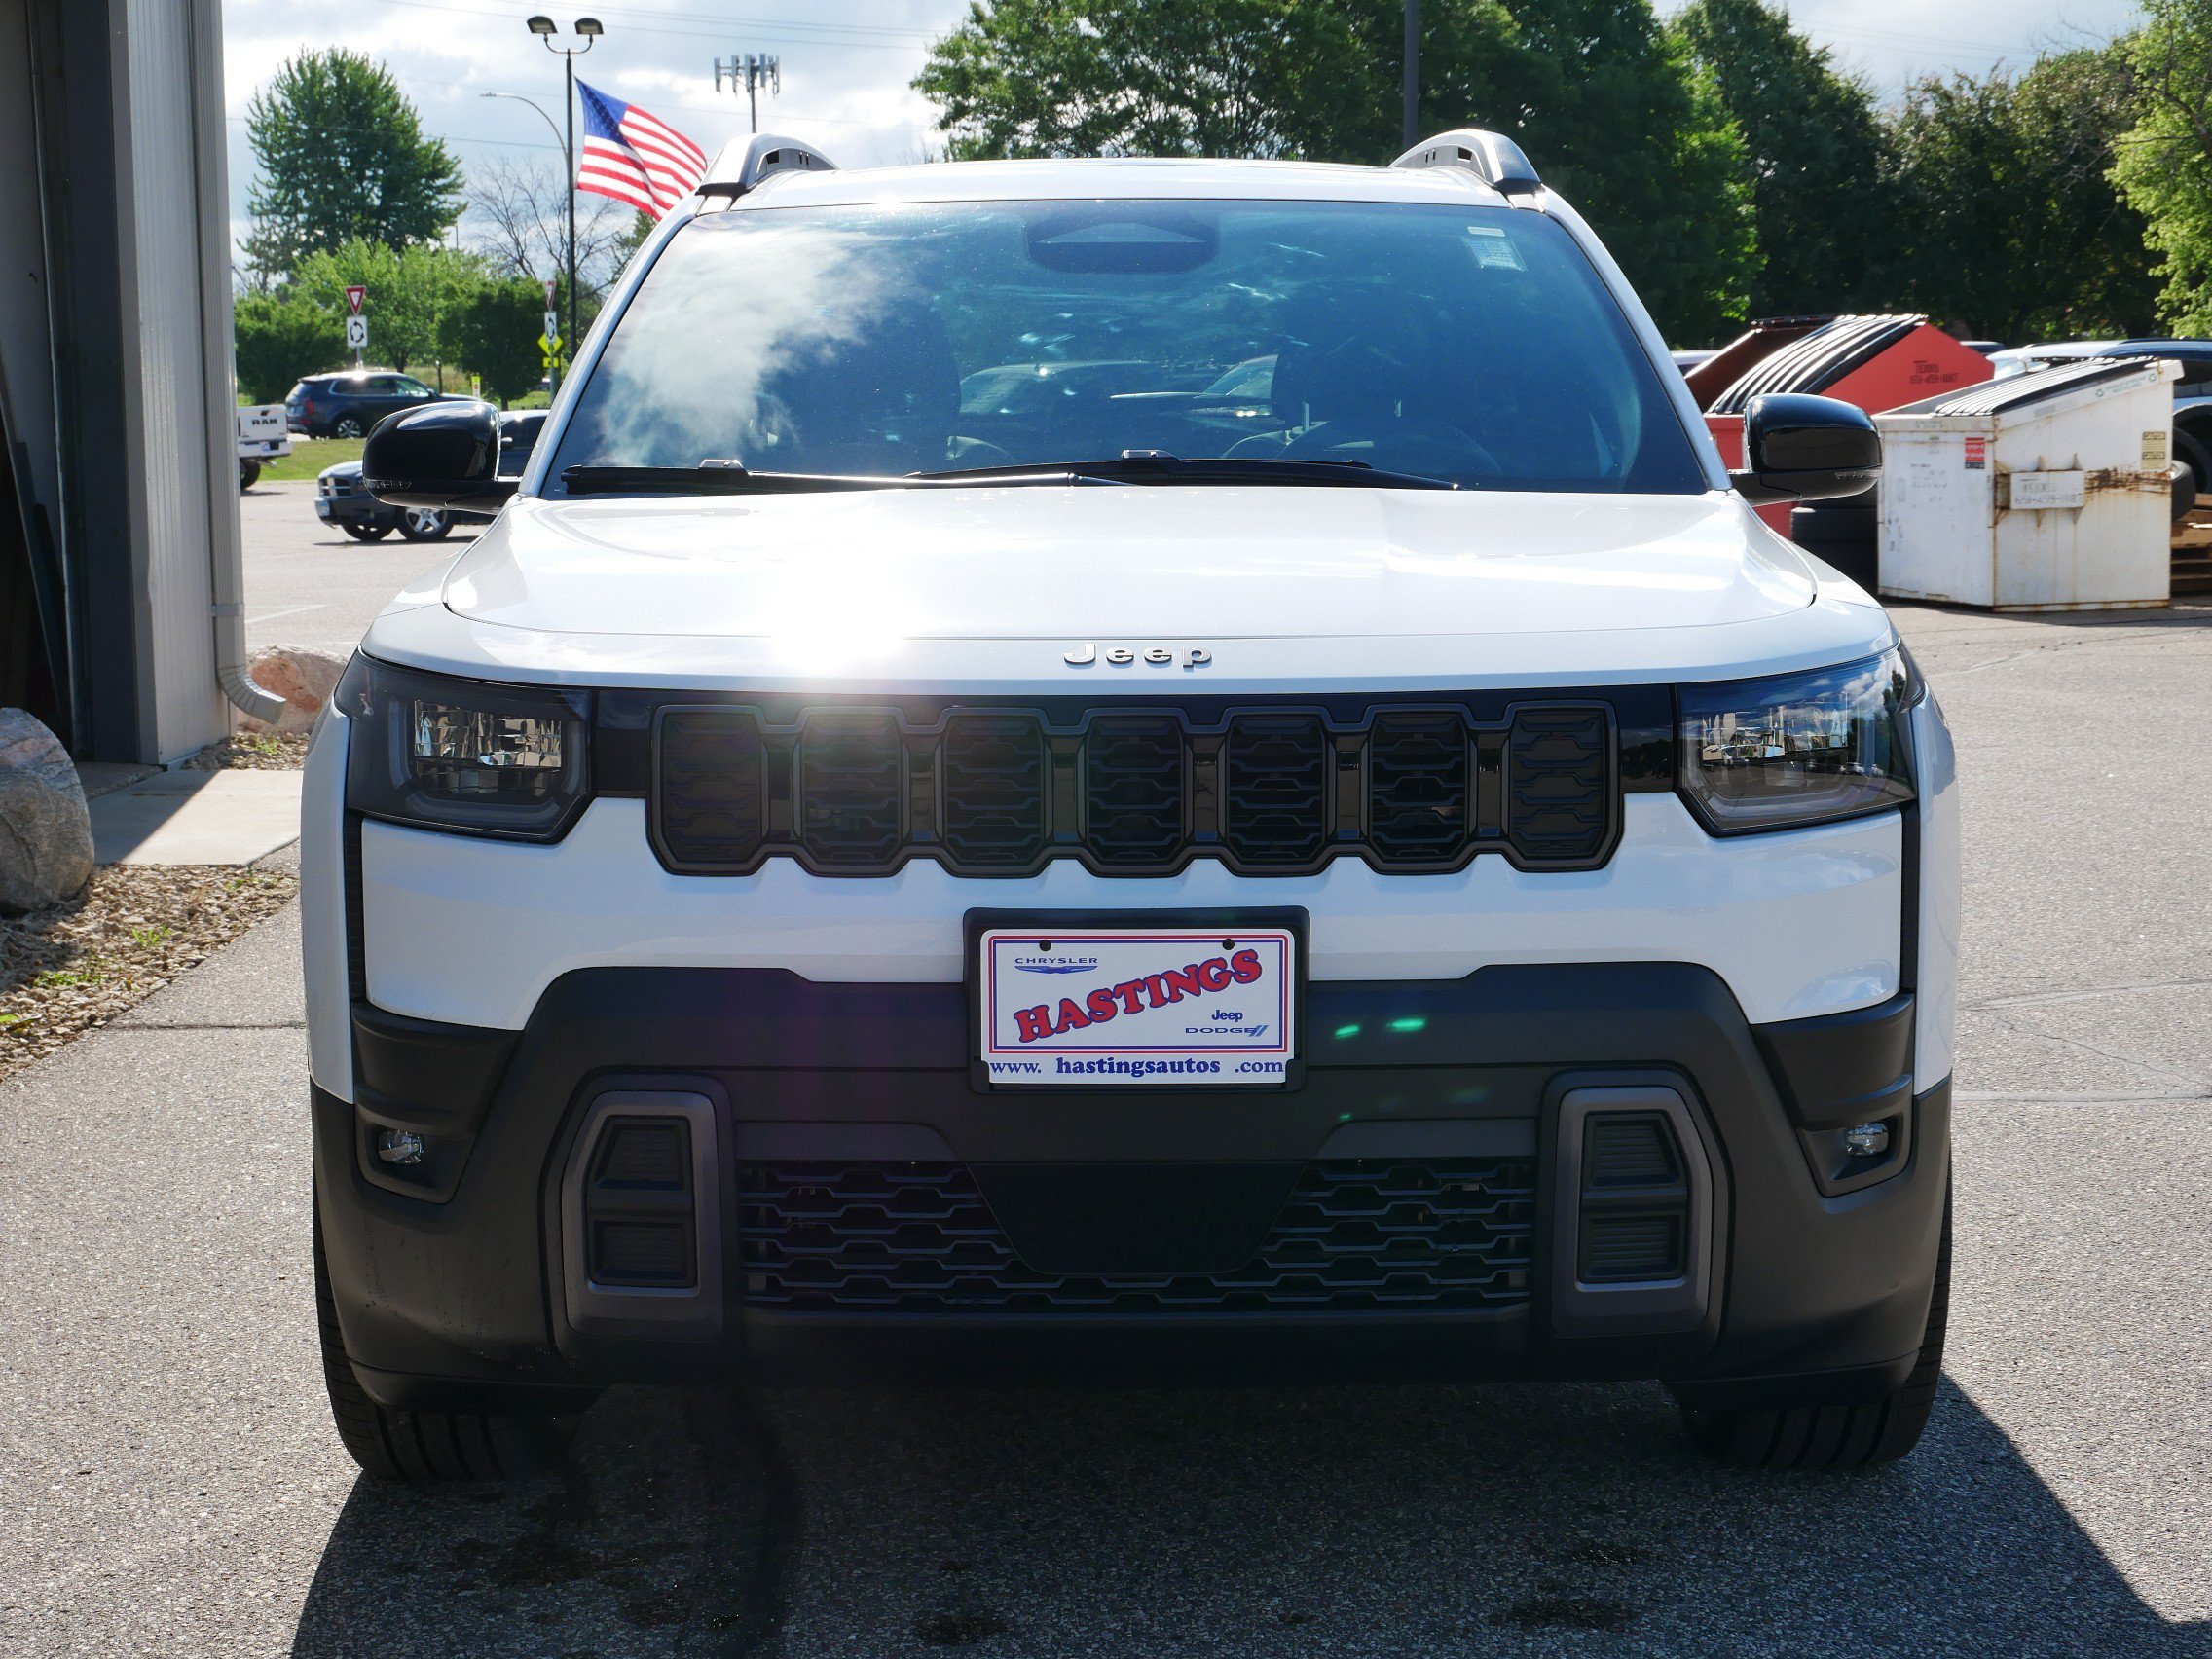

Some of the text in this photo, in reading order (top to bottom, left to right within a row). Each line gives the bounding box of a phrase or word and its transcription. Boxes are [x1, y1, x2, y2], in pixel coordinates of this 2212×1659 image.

[1063, 643, 1212, 668] Jeep
[1014, 949, 1263, 1043] HASTINGS
[1211, 1009, 1243, 1022] Jeep
[990, 1057, 1284, 1078] www. hastingsautos .com
